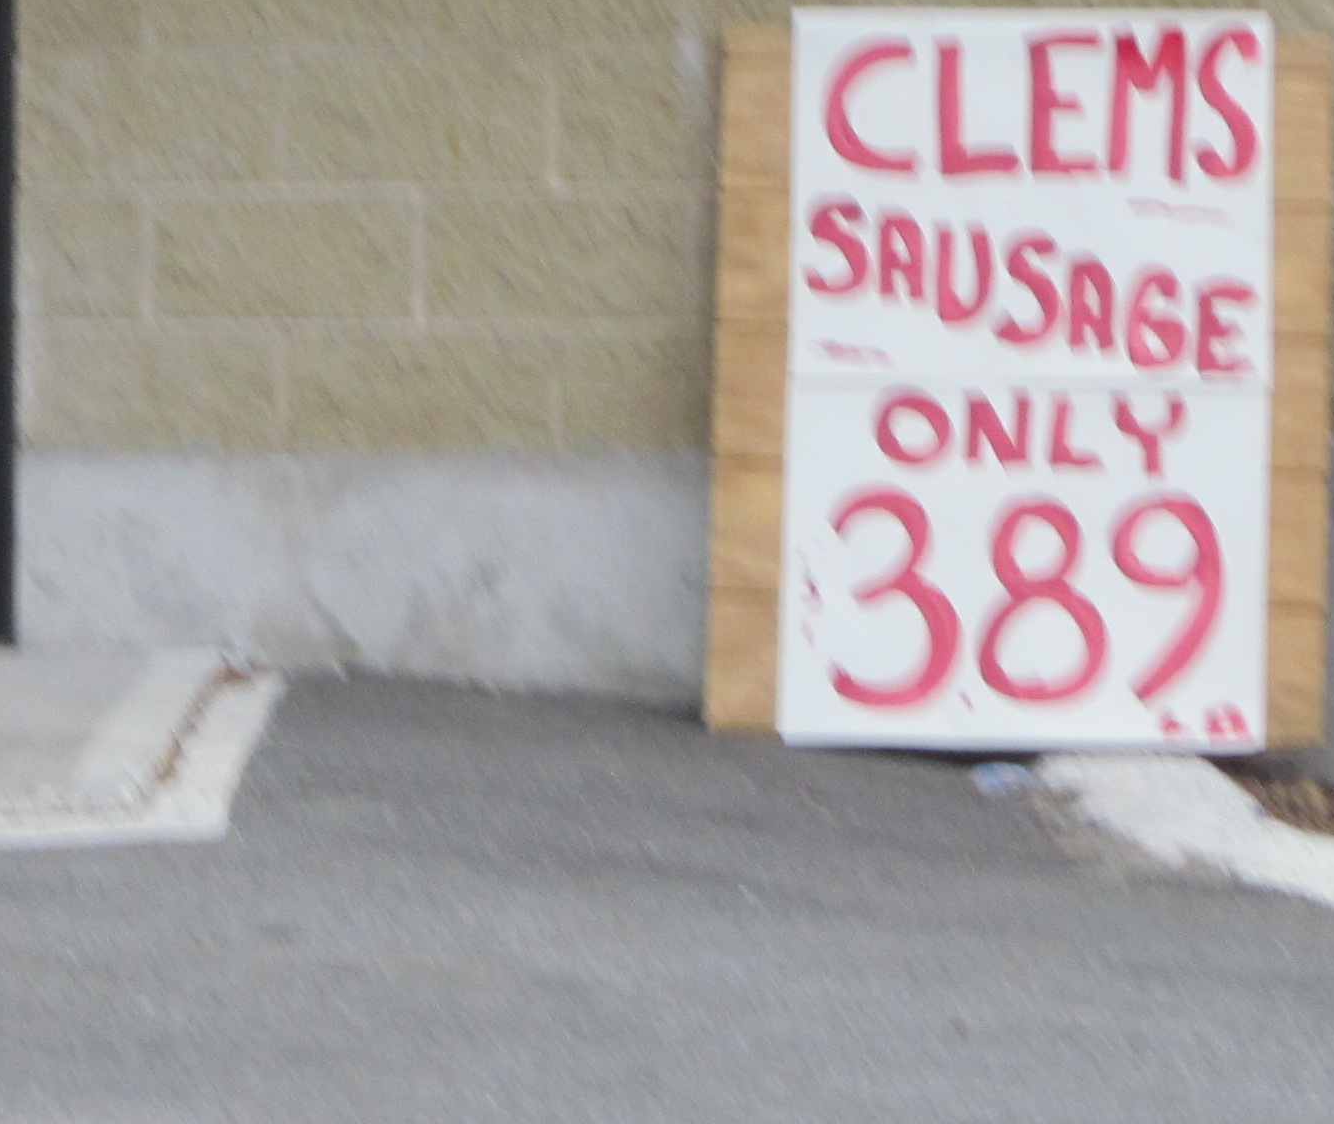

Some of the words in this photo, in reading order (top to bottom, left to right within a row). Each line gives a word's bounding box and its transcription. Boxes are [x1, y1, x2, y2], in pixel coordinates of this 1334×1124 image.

[825, 24, 1261, 186] CLEMS
[803, 196, 1259, 376] SAUSAGE
[875, 388, 1187, 476] ONLY
